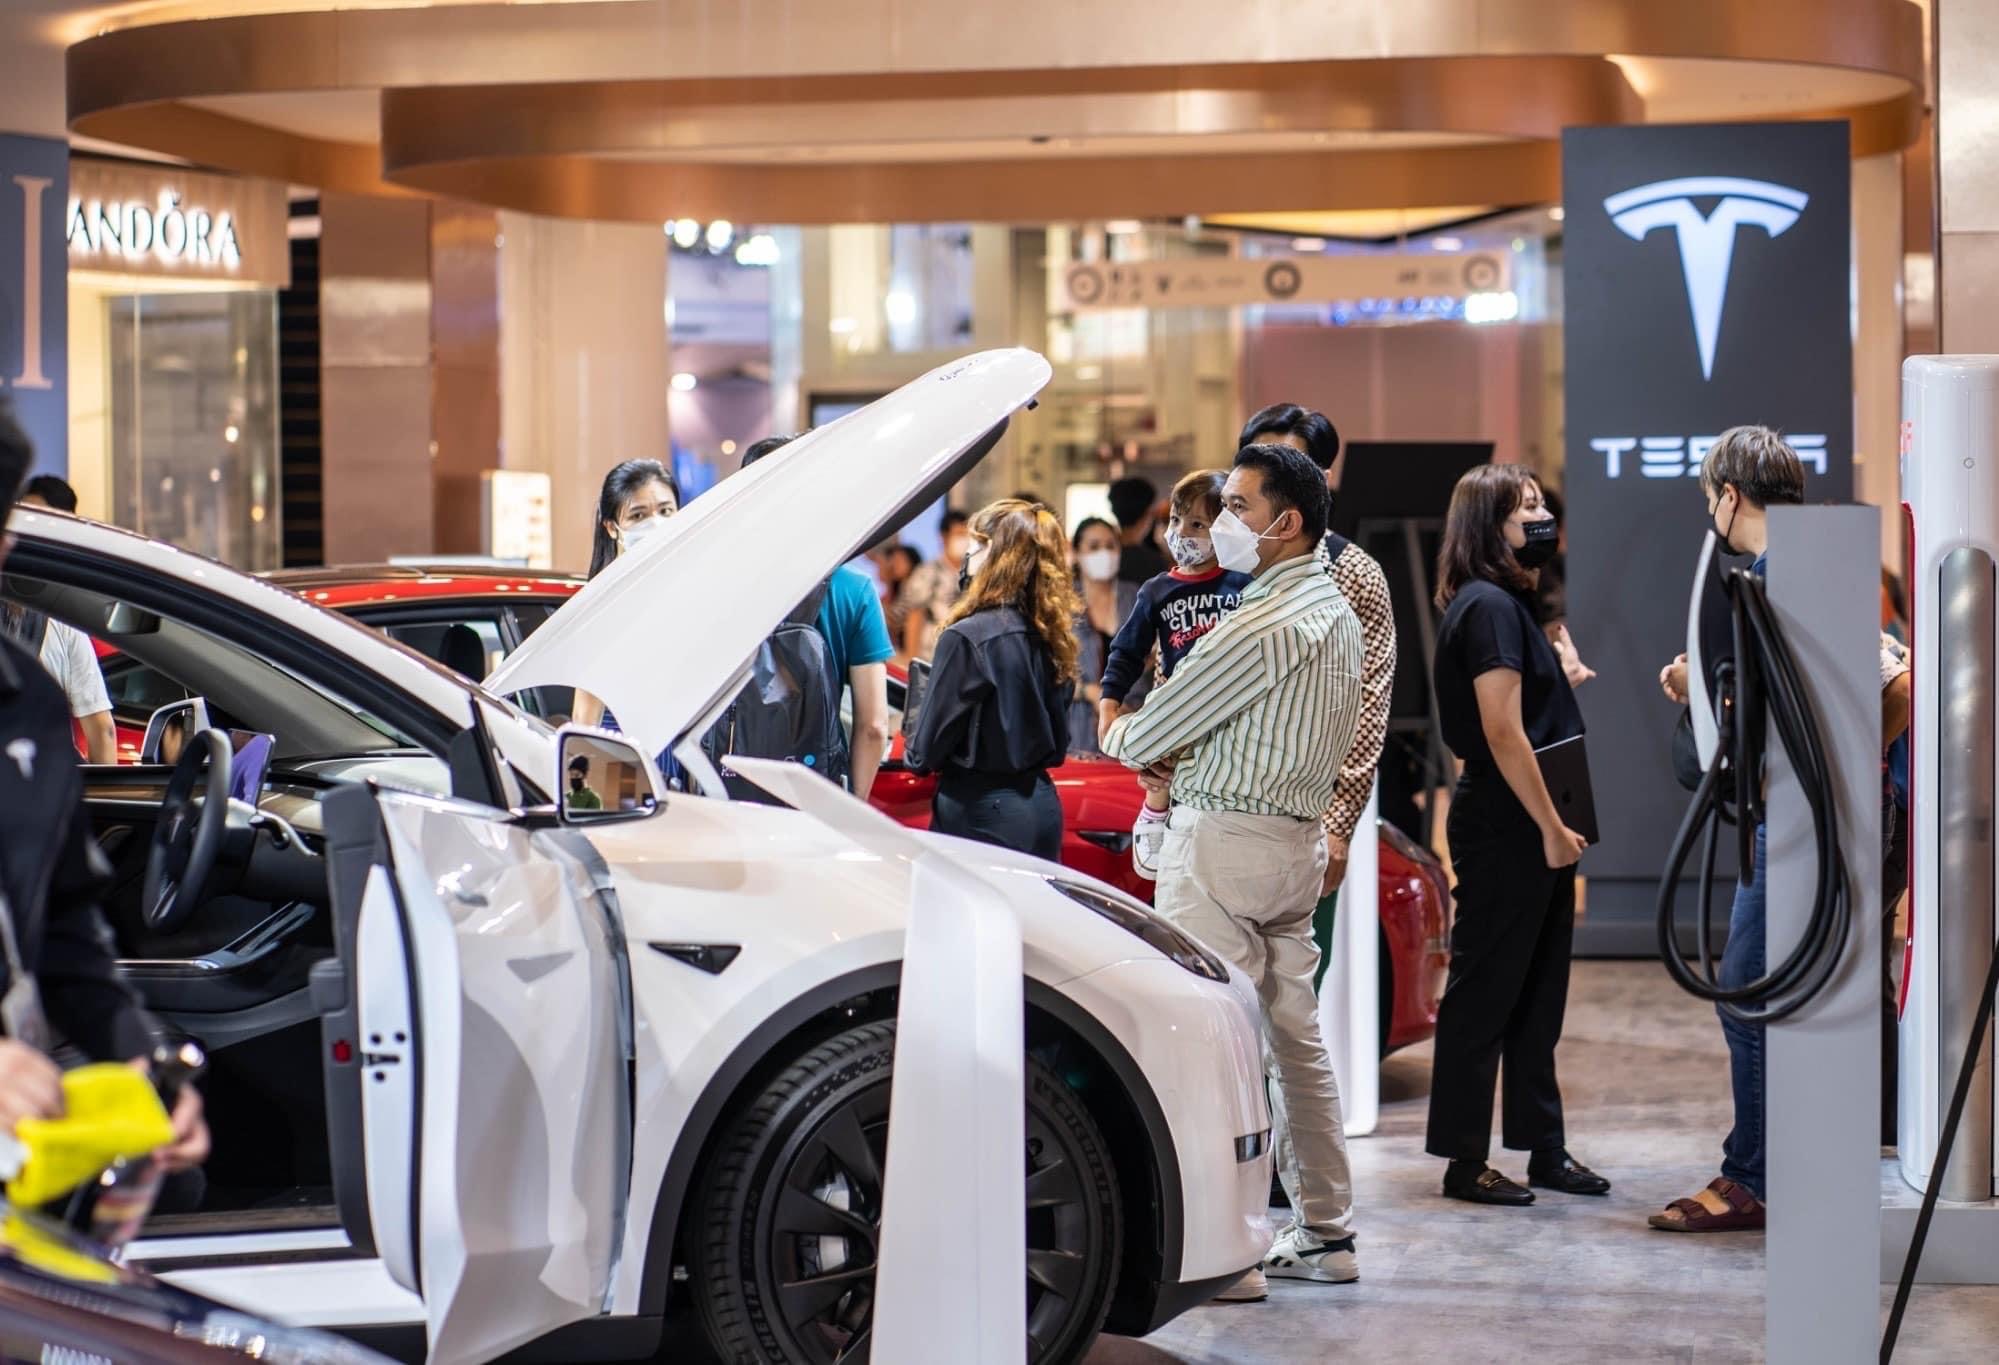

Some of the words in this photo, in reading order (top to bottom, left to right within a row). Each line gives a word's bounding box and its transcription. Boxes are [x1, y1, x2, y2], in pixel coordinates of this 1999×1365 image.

[1590, 434, 1827, 478] TESA
[1160, 593, 1241, 621] MOUNTAI
[1169, 608, 1232, 632] CLIM
